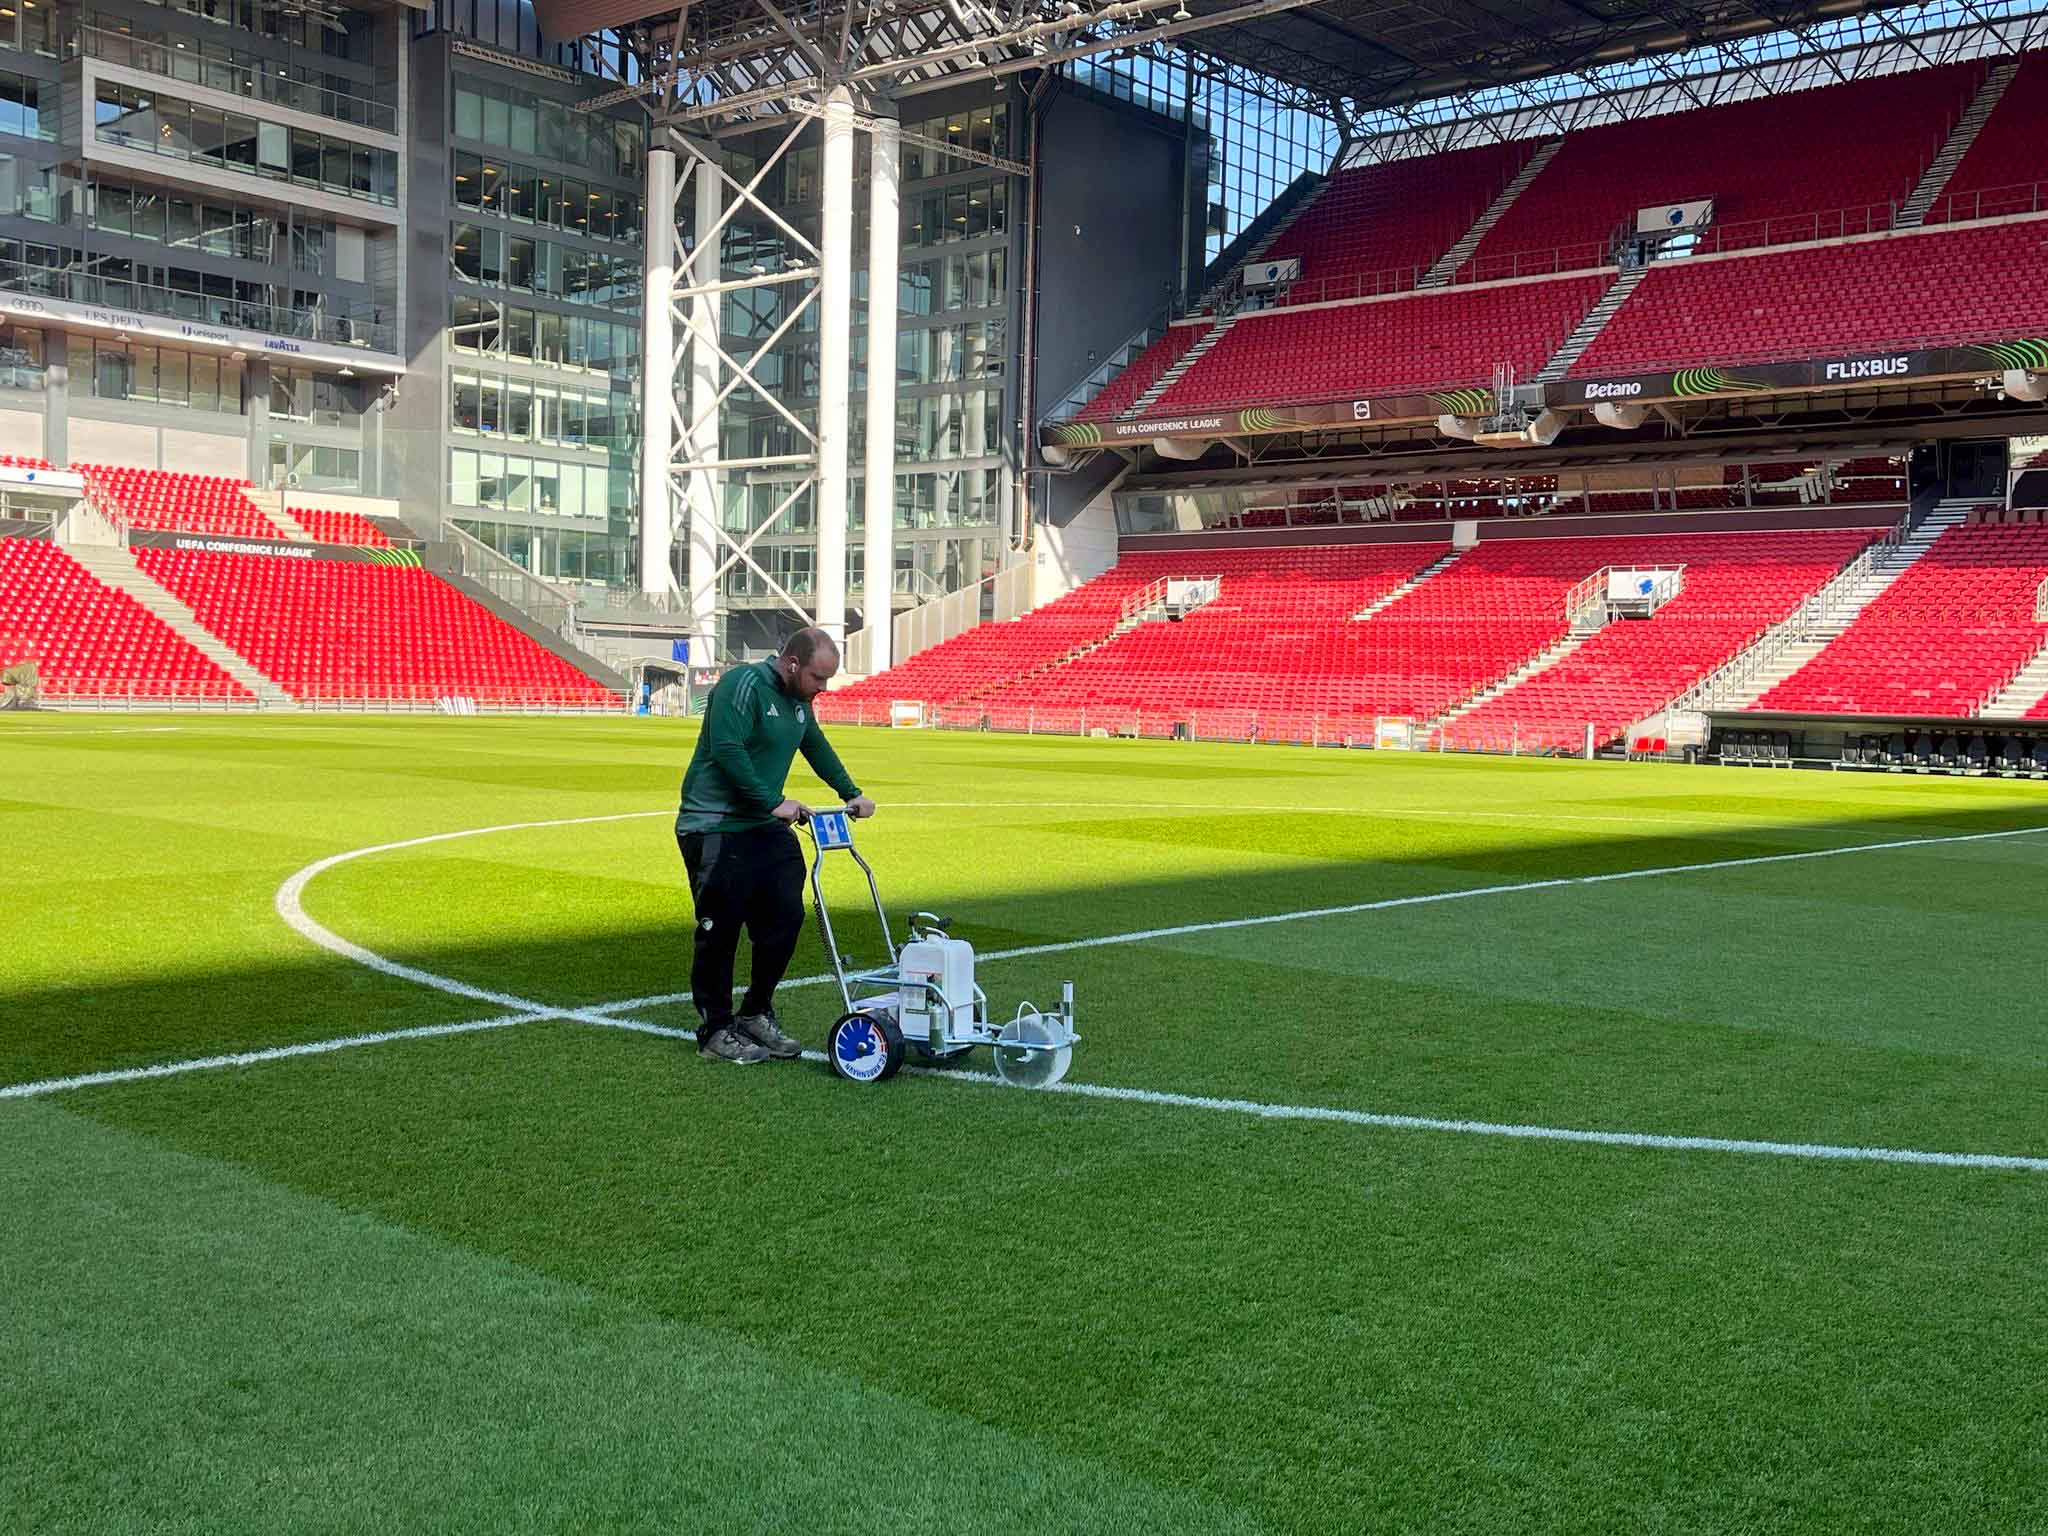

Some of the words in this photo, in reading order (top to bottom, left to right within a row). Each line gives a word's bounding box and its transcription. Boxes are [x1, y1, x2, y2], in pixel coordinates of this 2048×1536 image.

[1585, 382, 1641, 398] Betano
[1117, 426, 1137, 434] UEFA
[1138, 421, 1188, 433] CONFERENCE
[1190, 419, 1221, 428] LEAGUE
[176, 539, 204, 550] UEFA
[206, 541, 272, 555] CONFERENCE
[274, 546, 312, 557] LEAGUE
